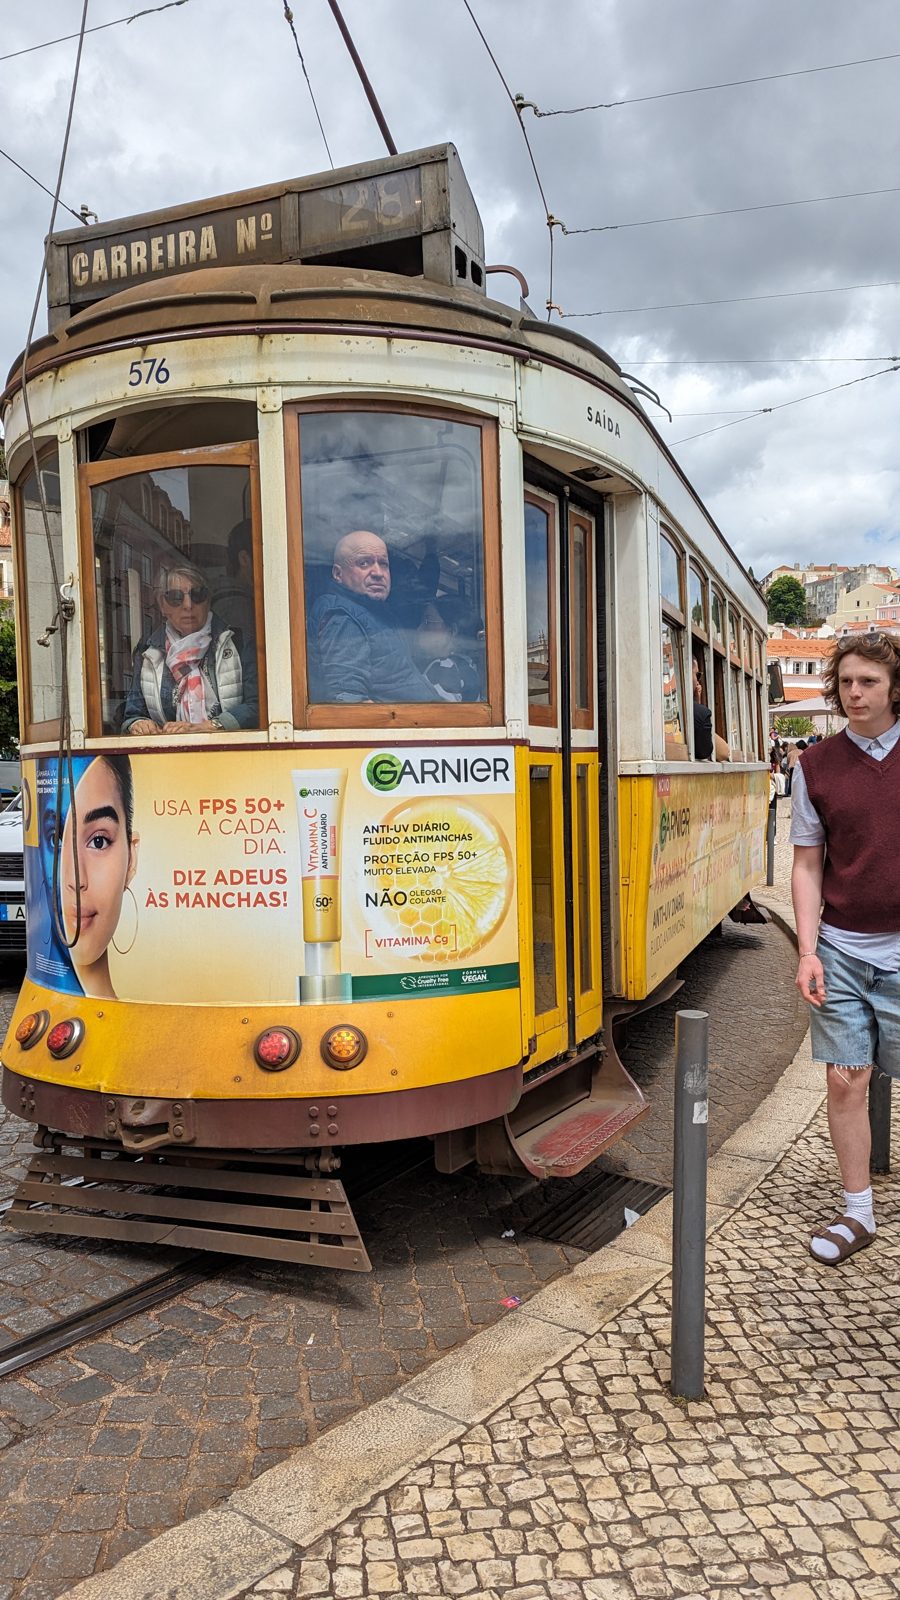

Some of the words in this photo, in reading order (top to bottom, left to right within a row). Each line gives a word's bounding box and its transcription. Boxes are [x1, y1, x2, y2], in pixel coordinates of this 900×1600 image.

[72, 225, 218, 287] CARREIRA
[236, 212, 273, 254] Nº
[128, 358, 170, 386] 576
[587, 406, 620, 438] SAÍDA
[372, 757, 510, 785] GARNIER
[153, 799, 192, 816] USA
[199, 798, 237, 815] FPS
[244, 797, 285, 814] 50+
[304, 808, 317, 818] C
[197, 819, 212, 835] A
[218, 818, 286, 835] CADA.
[363, 824, 410, 834] ANTI-UV
[412, 821, 450, 833] DIÁRIO
[244, 838, 286, 855] DIA.
[308, 822, 318, 872] VITAMINA
[363, 837, 400, 845] FLUIDO
[403, 833, 473, 844] ANTIMANCHAS
[364, 851, 430, 864] PROTEÇÃO
[433, 852, 454, 861] FPS
[457, 850, 477, 860] 50+
[173, 870, 206, 886] DIZ
[213, 868, 288, 885] ADEUS
[364, 868, 393, 876] MUITO
[395, 866, 437, 875] ELEVADA
[145, 887, 169, 908] ÀS
[175, 891, 288, 908] MANCHAS!
[365, 888, 408, 907] NÃO
[409, 889, 442, 897] OLEOSO
[409, 896, 447, 904] COLANTE
[375, 936, 431, 948] VITAMINA
[462, 974, 487, 982] VEGAN
